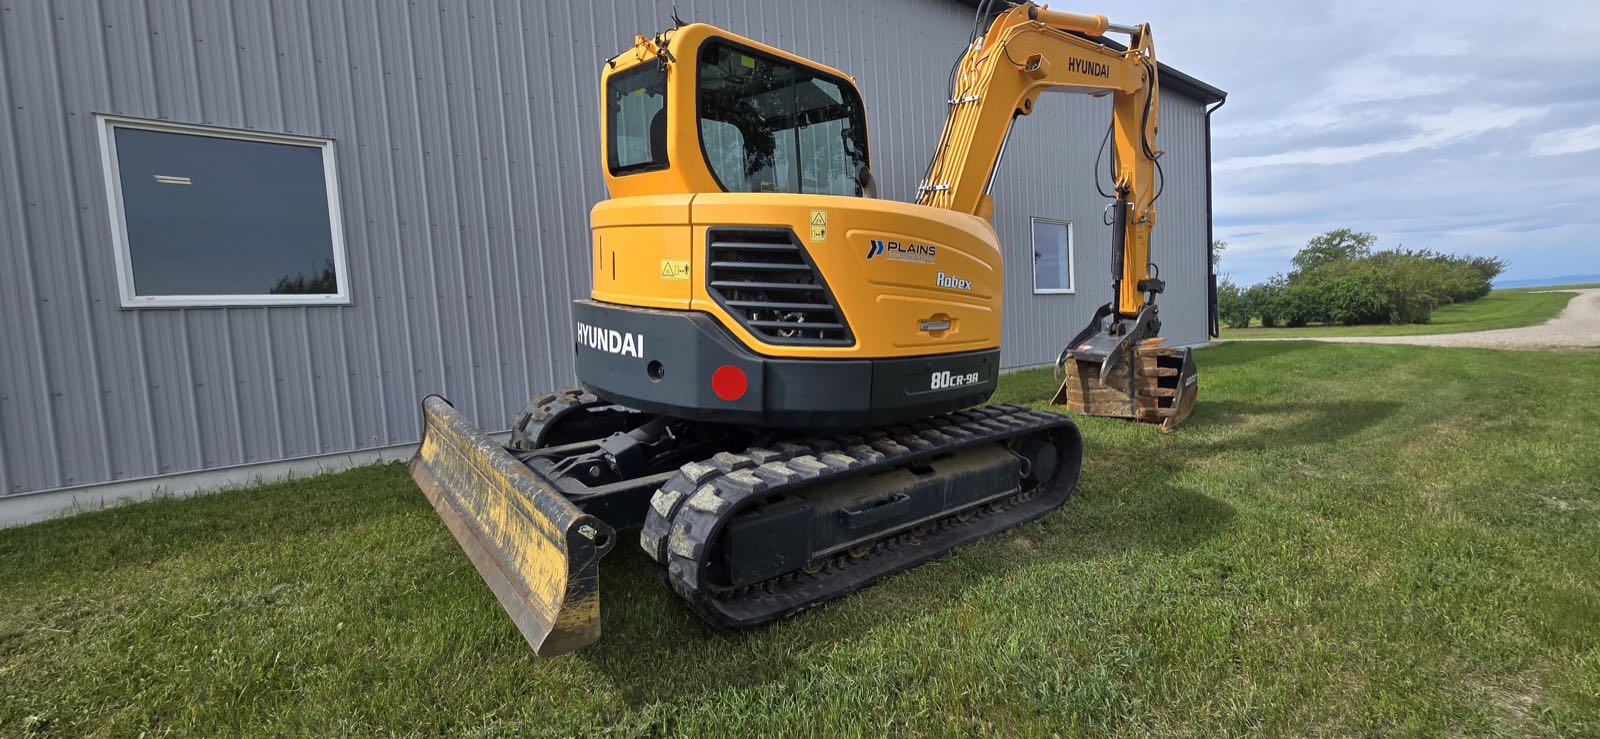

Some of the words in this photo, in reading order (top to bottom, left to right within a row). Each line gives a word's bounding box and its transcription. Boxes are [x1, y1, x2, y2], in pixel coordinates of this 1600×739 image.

[1068, 57, 1110, 79] HYUNDAI
[887, 241, 936, 256] PLAINS
[936, 271, 973, 291] Robex
[577, 321, 644, 359] HYUNDAI
